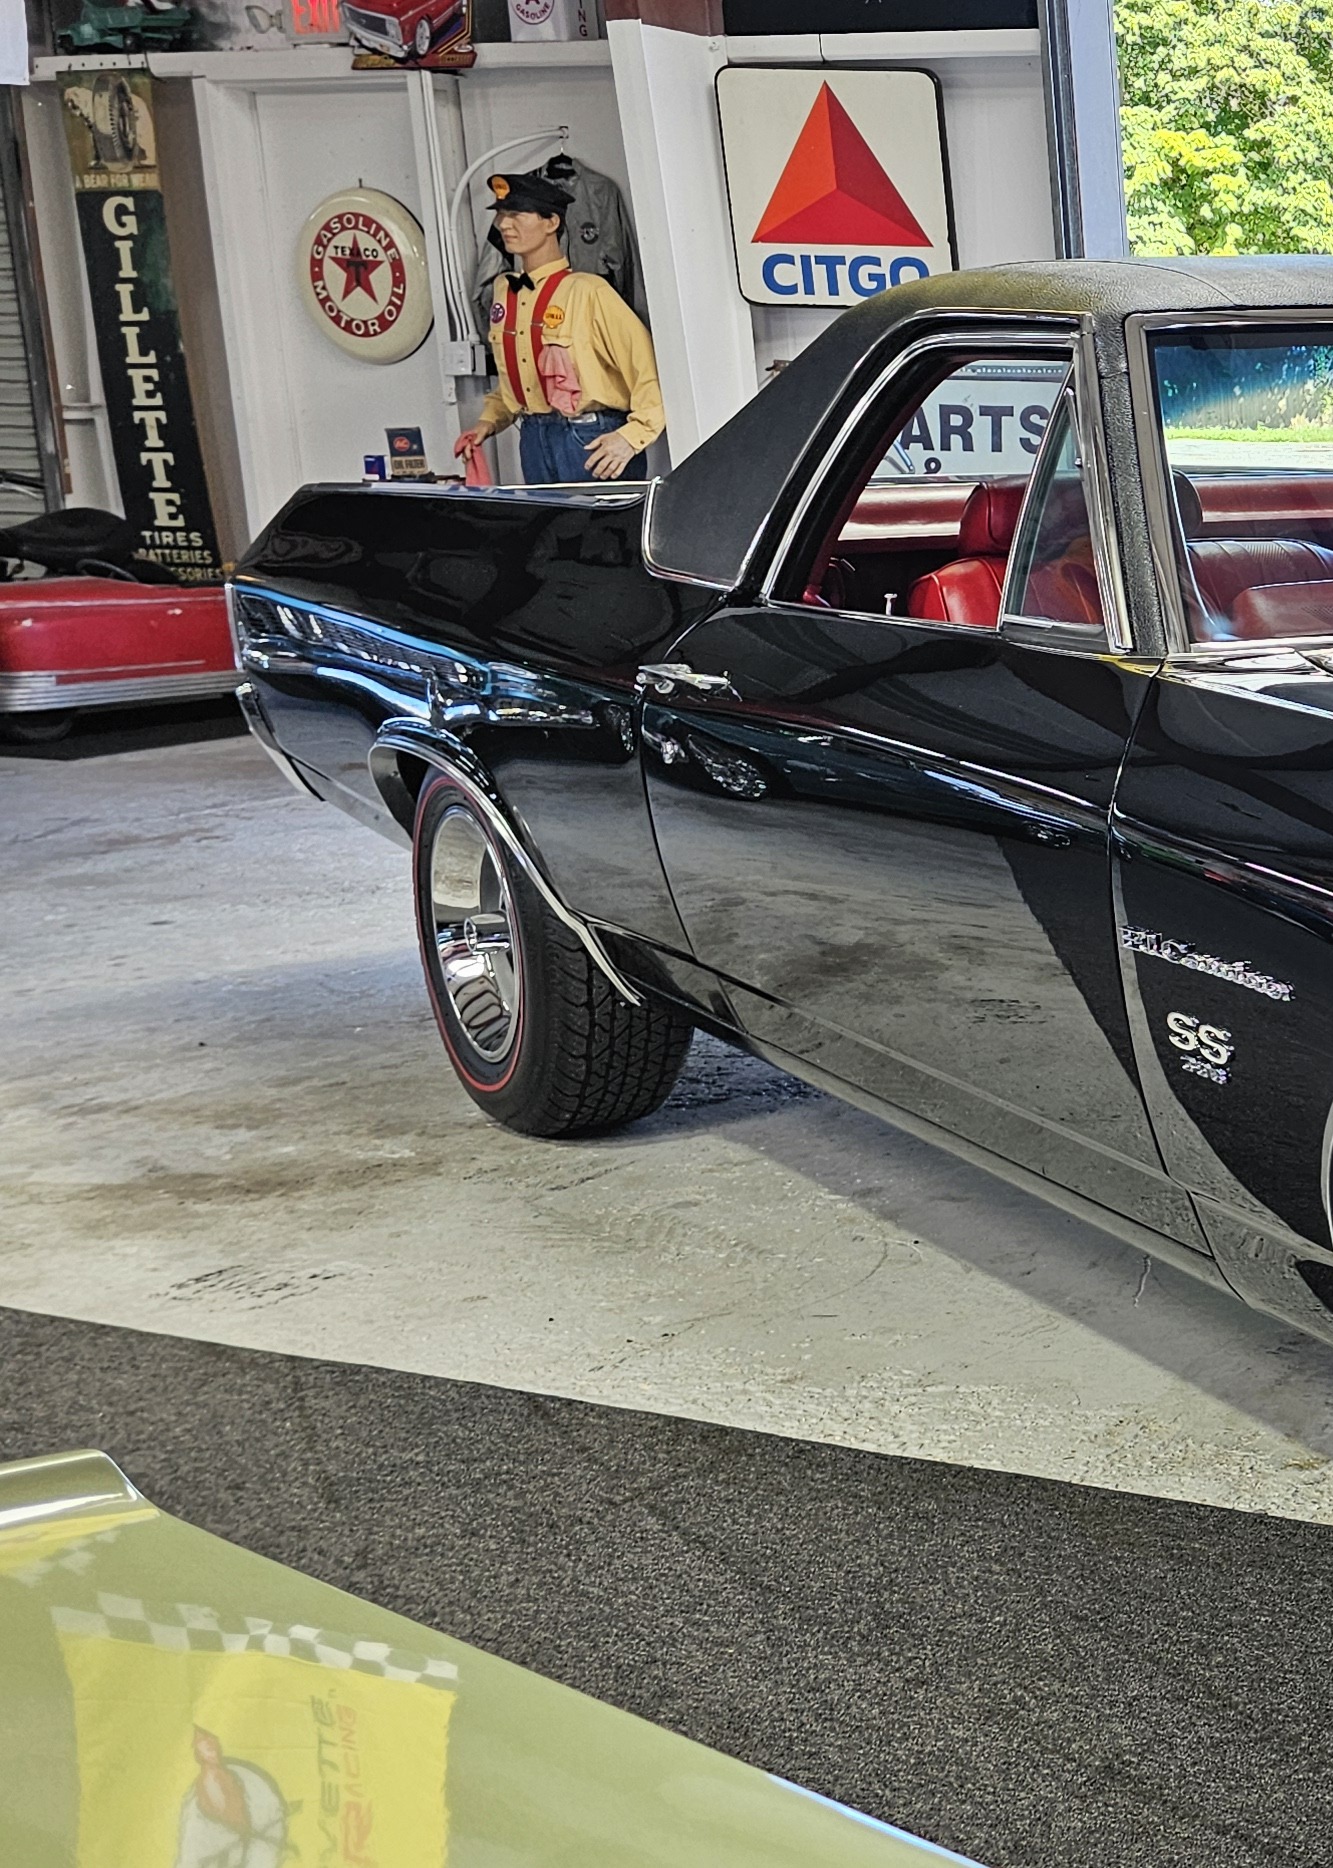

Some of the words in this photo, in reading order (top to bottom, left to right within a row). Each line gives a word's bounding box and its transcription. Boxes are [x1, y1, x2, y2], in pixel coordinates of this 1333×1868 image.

[515, 2, 551, 20] GASOLINE
[312, 214, 400, 263] GASOLINE
[762, 253, 930, 298] CITGO
[313, 280, 381, 335] MOTOR
[384, 283, 404, 321] OIL
[102, 195, 186, 527] GILLETTE
[899, 403, 1053, 455] ARTS
[137, 547, 213, 564] BATTERIES
[140, 530, 204, 547] TIRES
[1166, 1011, 1235, 1065] SS
